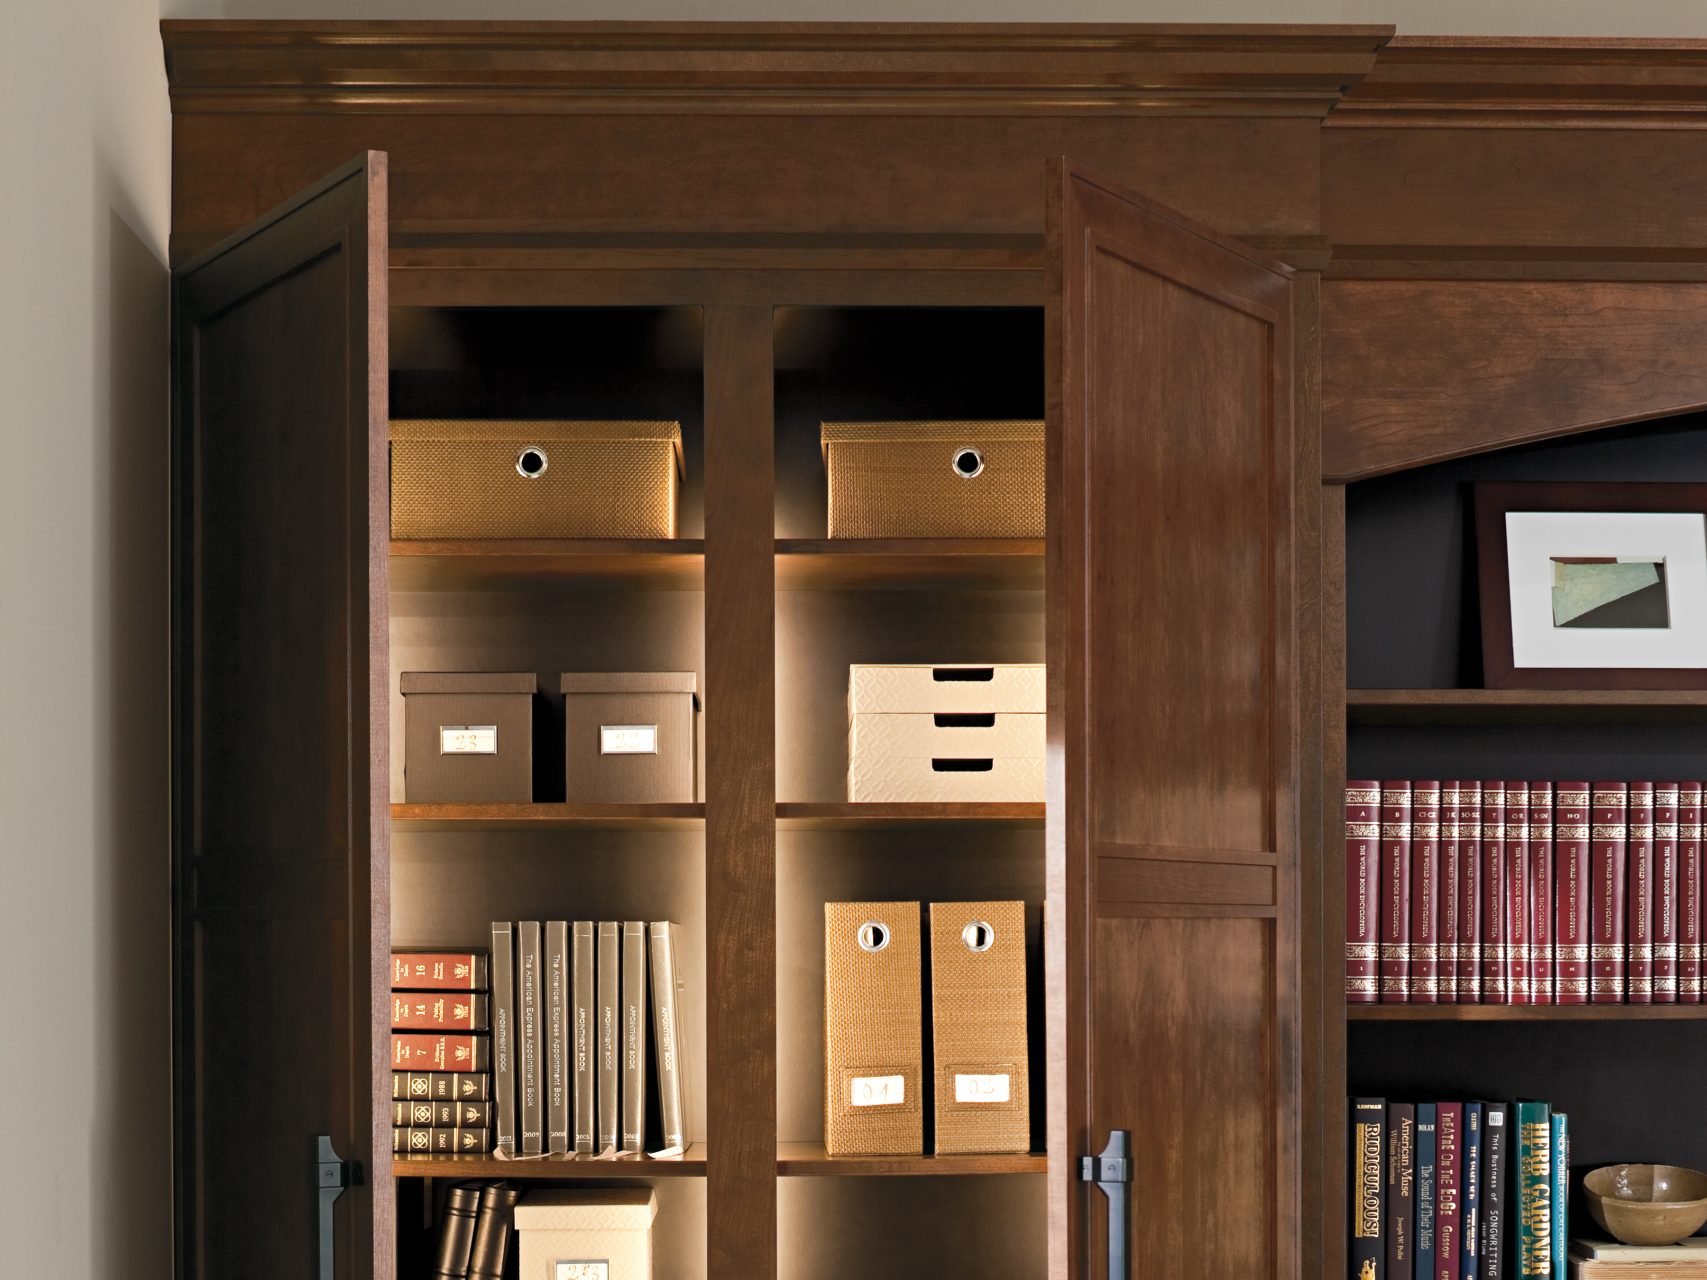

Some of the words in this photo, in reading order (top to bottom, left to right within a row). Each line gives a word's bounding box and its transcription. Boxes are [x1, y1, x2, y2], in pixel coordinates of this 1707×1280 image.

[456, 735, 477, 750] 23
[1422, 857, 1430, 877] WORLD
[1422, 879, 1430, 894] BOOK
[1422, 896, 1430, 937] ENCYCLOPEDIA
[416, 965, 426, 976] 16
[552, 954, 560, 968] The
[525, 970, 533, 1005] American
[553, 970, 561, 1005] American
[416, 1005, 426, 1016] 14
[525, 1007, 533, 1037] Express
[552, 1007, 561, 1037] Express
[661, 1007, 672, 1052] APPOINTMENT
[526, 1038, 534, 1086] Appointment
[552, 1038, 561, 1085] Appointment
[665, 1052, 673, 1071] BOOK
[438, 1080, 446, 1096] 1988
[527, 1088, 535, 1107] Book
[554, 1087, 562, 1106] Book
[1402, 1117, 1413, 1166] American
[1491, 1133, 1499, 1151] This
[1521, 1123, 1531, 1146] THE
[1557, 1133, 1567, 1152] NEW
[1531, 1122, 1550, 1176] HERB
[1363, 1123, 1381, 1238] RIDICULOUS!
[1389, 1156, 1397, 1185] Schuman
[1401, 1168, 1413, 1197] Muse
[1421, 1165, 1433, 1178] The
[1491, 1154, 1499, 1188] Business
[1421, 1179, 1433, 1200] Sound
[1490, 1192, 1498, 1203] of
[1521, 1156, 1531, 1227] COLLECTED
[1421, 1201, 1433, 1209] of
[1421, 1210, 1433, 1228] Their
[1530, 1183, 1550, 1276] GARDNER
[1420, 1229, 1432, 1250] Music
[1441, 1225, 1453, 1260] GUSSOW
[1488, 1210, 1499, 1277] SONGWRITING
[1521, 1236, 1531, 1275] PLAYS
